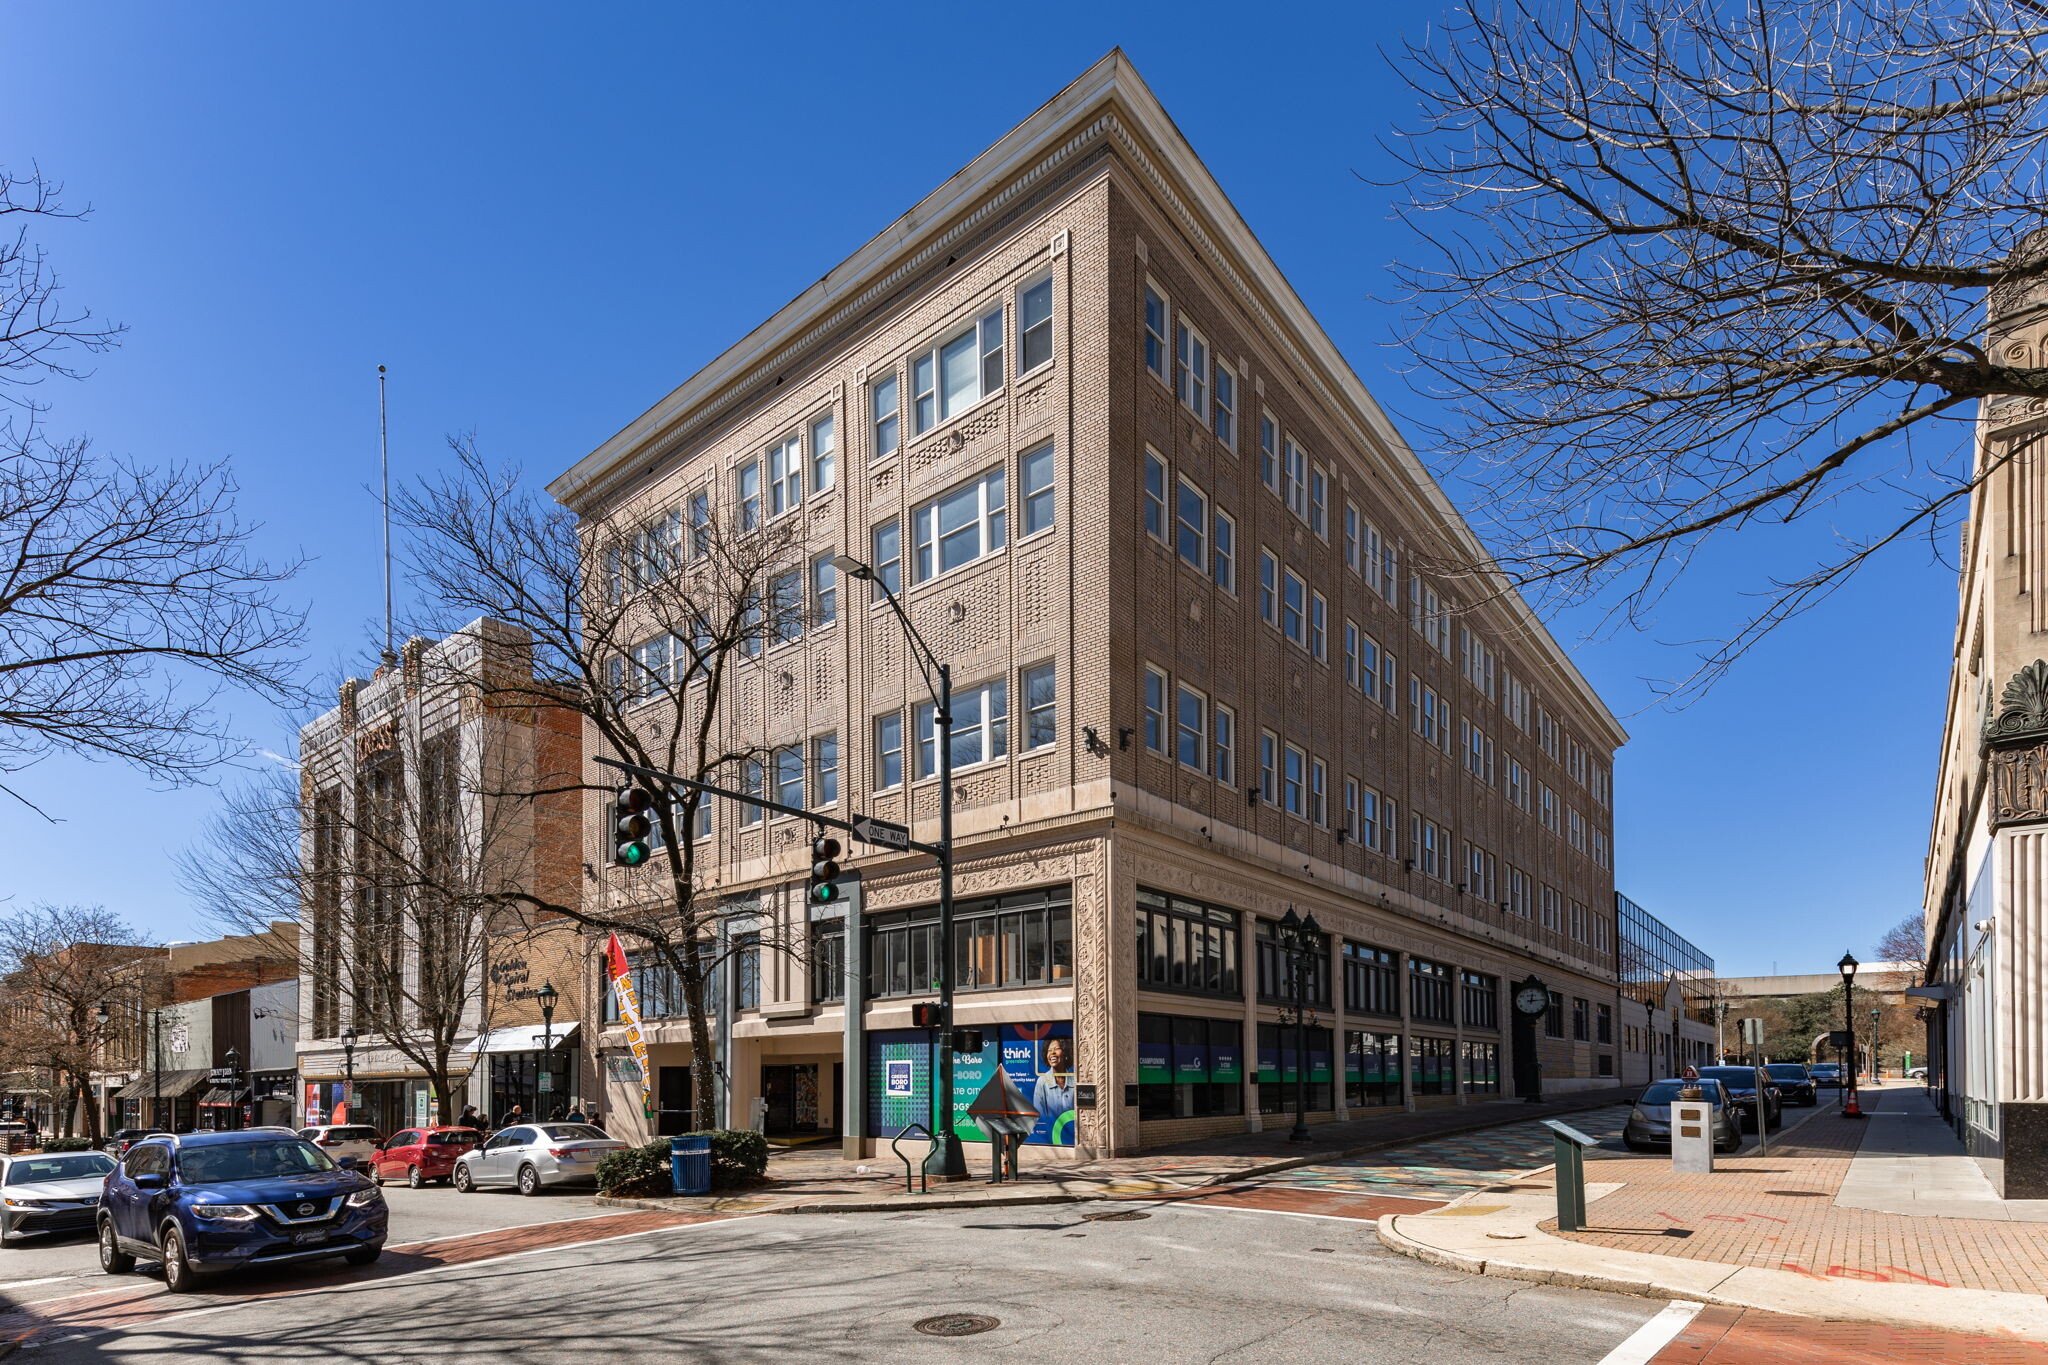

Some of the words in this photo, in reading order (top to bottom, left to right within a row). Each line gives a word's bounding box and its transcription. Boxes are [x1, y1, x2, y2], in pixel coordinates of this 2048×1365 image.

[868, 826, 885, 839] ONE
[890, 831, 906, 843] WAY
[1003, 1047, 1031, 1059] think
[962, 1054, 983, 1065] Boro
[1139, 1057, 1165, 1065] CHAMPIONING
[952, 1070, 982, 1080] -BORO
